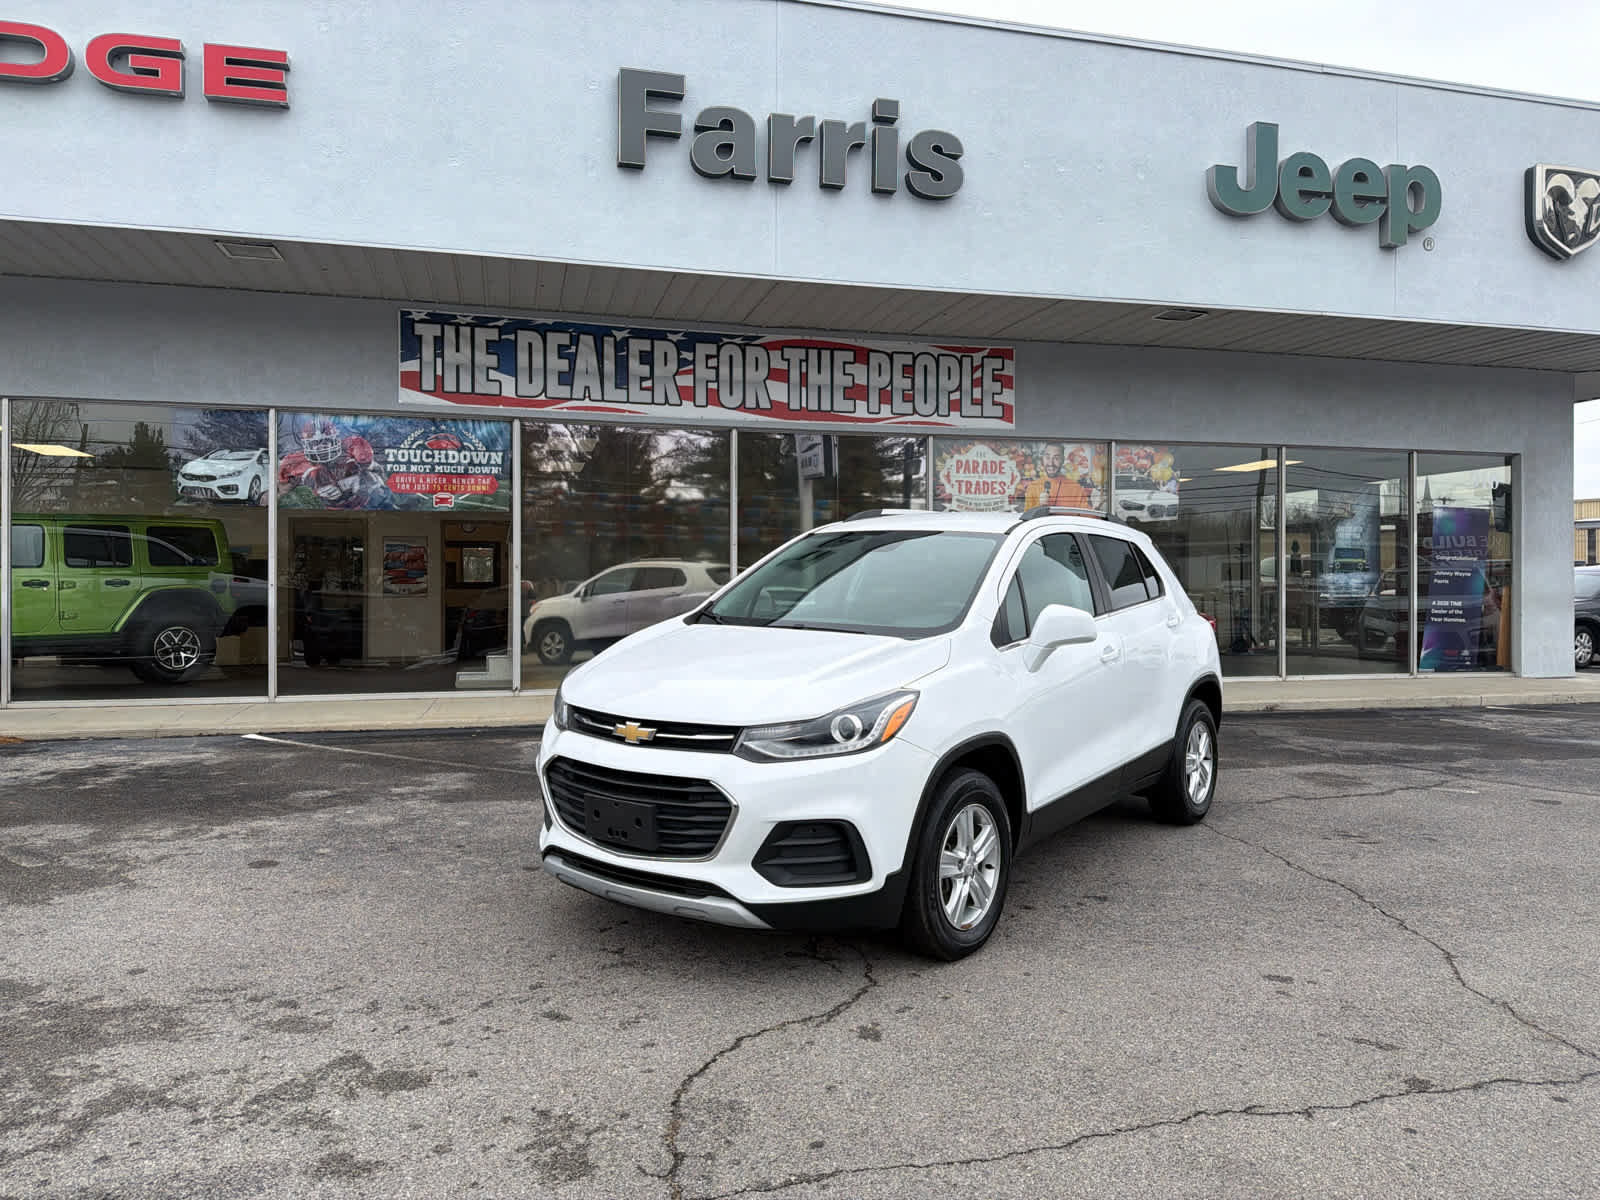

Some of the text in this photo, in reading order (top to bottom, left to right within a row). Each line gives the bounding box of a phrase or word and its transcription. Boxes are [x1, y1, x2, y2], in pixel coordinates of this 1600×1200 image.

[616, 66, 965, 201] Farris
[1206, 121, 1442, 249] Jeep
[414, 321, 1006, 418] THE DEALER FOR THE PEOPLE
[385, 448, 503, 465] TOUCHDOWN
[386, 463, 502, 474] FOR NOT MUCH DOWN!
[955, 459, 1007, 475] PARADE
[955, 479, 1007, 496] TRADES
